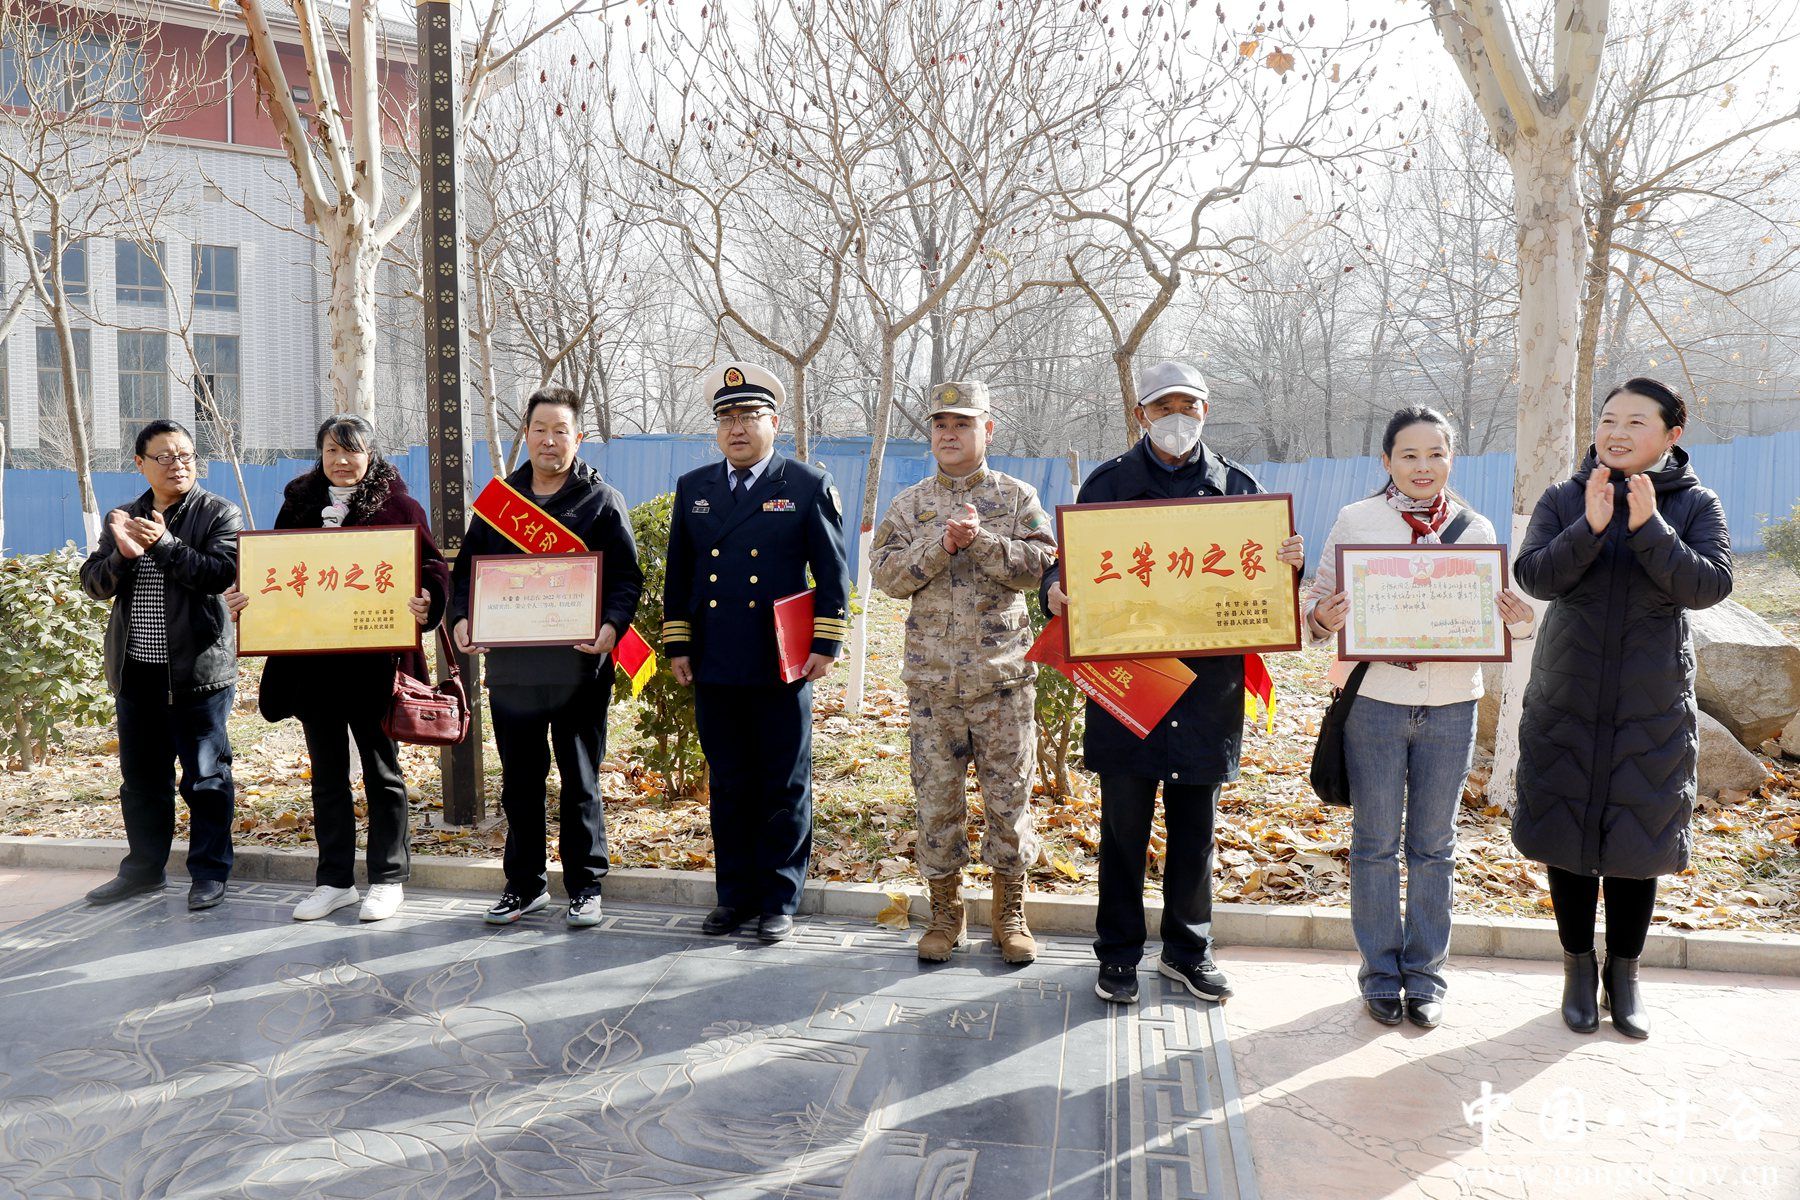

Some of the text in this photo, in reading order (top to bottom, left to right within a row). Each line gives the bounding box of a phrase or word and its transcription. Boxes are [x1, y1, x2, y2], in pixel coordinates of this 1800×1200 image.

[499, 500, 576, 553] 一人立功
[259, 560, 395, 598] 三等功之家
[1093, 538, 1267, 588] 三等功之家
[1215, 599, 1268, 609] 中共甘谷县委
[1216, 608, 1268, 618] 甘谷县人民政府
[1077, 680, 1099, 697] EMS
[825, 1001, 989, 1033] 大丽花
